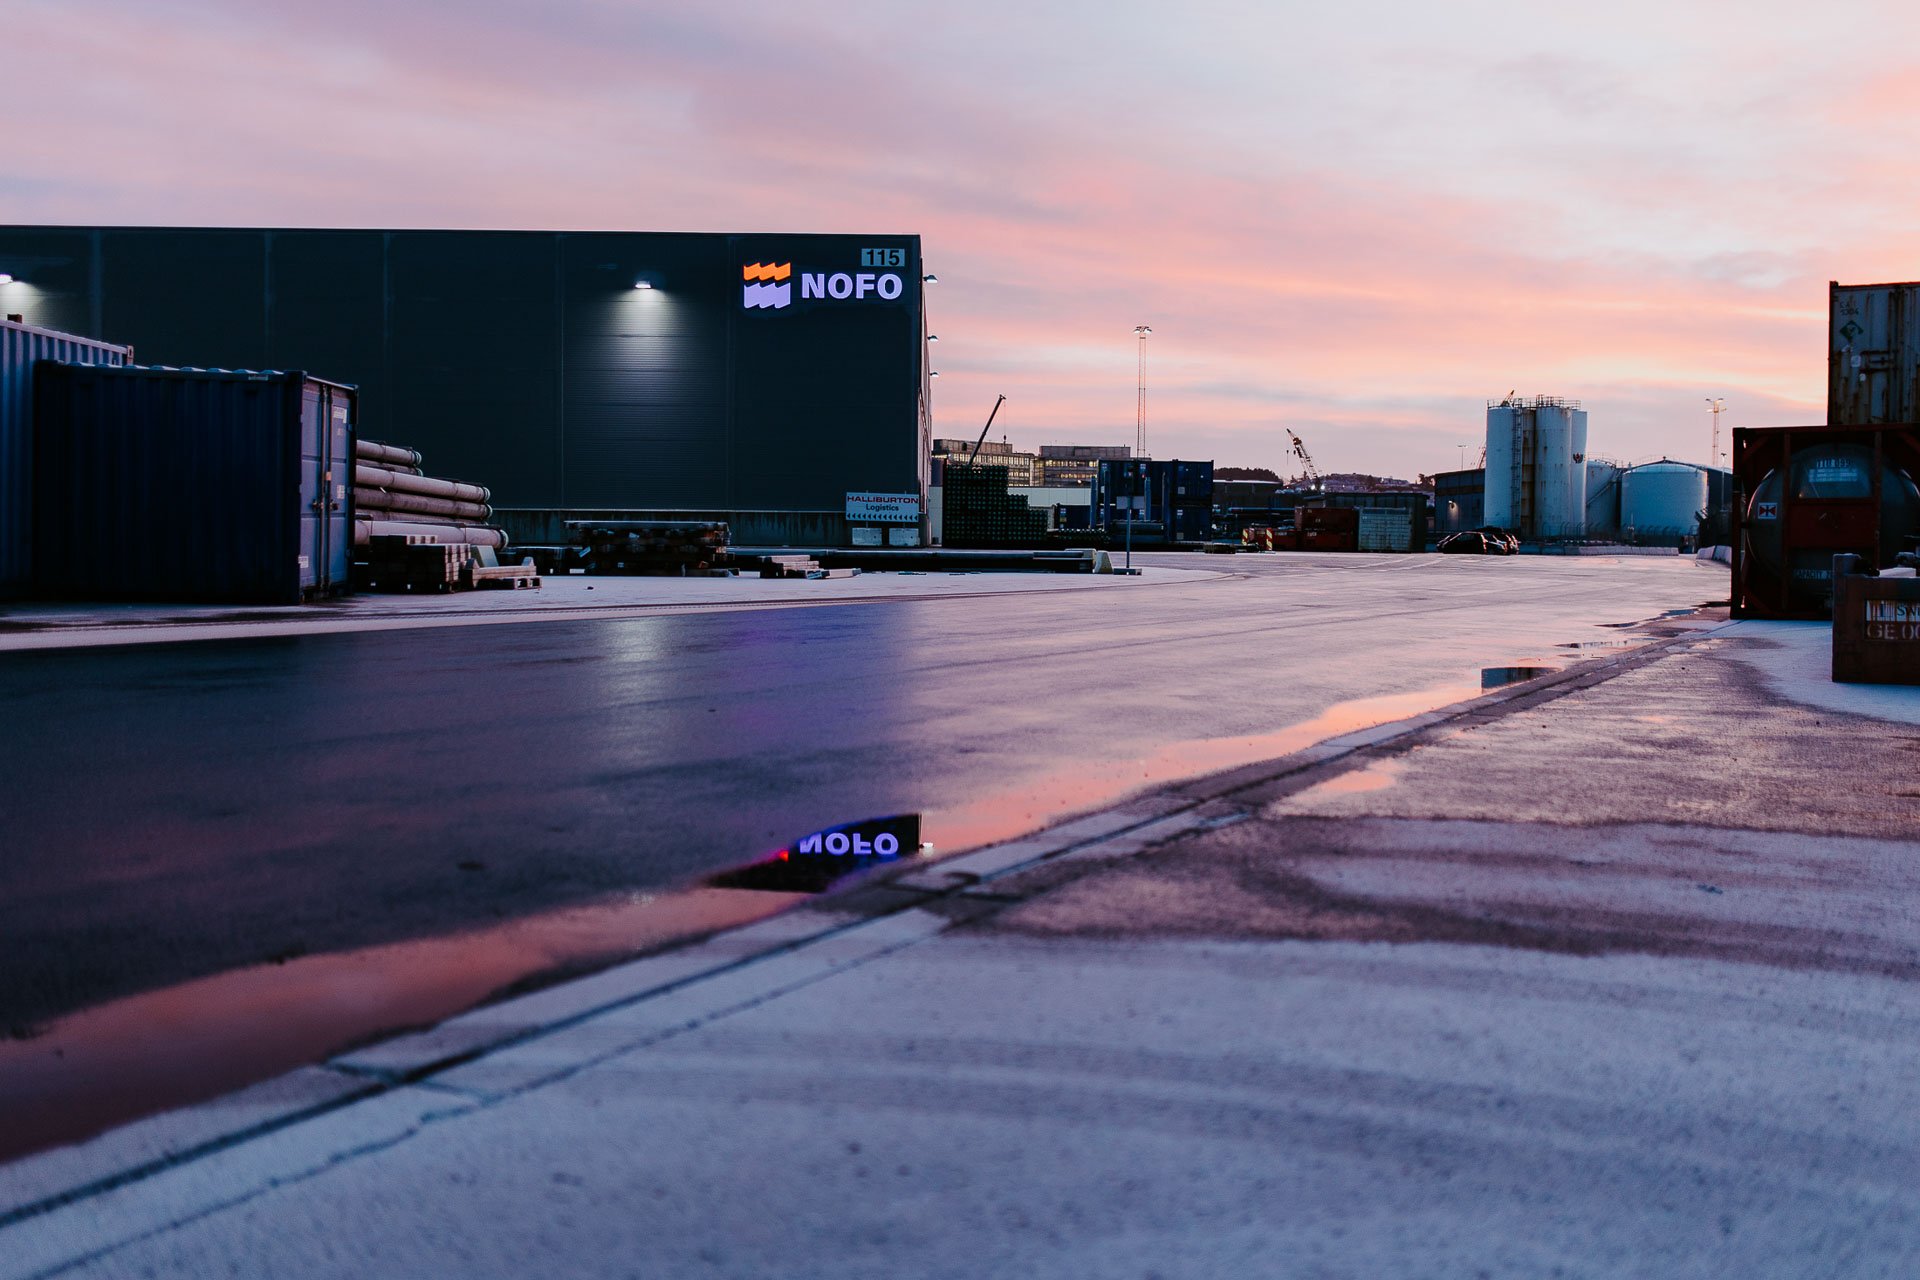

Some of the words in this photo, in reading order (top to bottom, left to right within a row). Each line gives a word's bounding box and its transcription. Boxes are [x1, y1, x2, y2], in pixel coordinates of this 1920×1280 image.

[867, 250, 899, 265] 115
[801, 273, 903, 300] NOFO
[847, 496, 918, 504] HALLIBURTON
